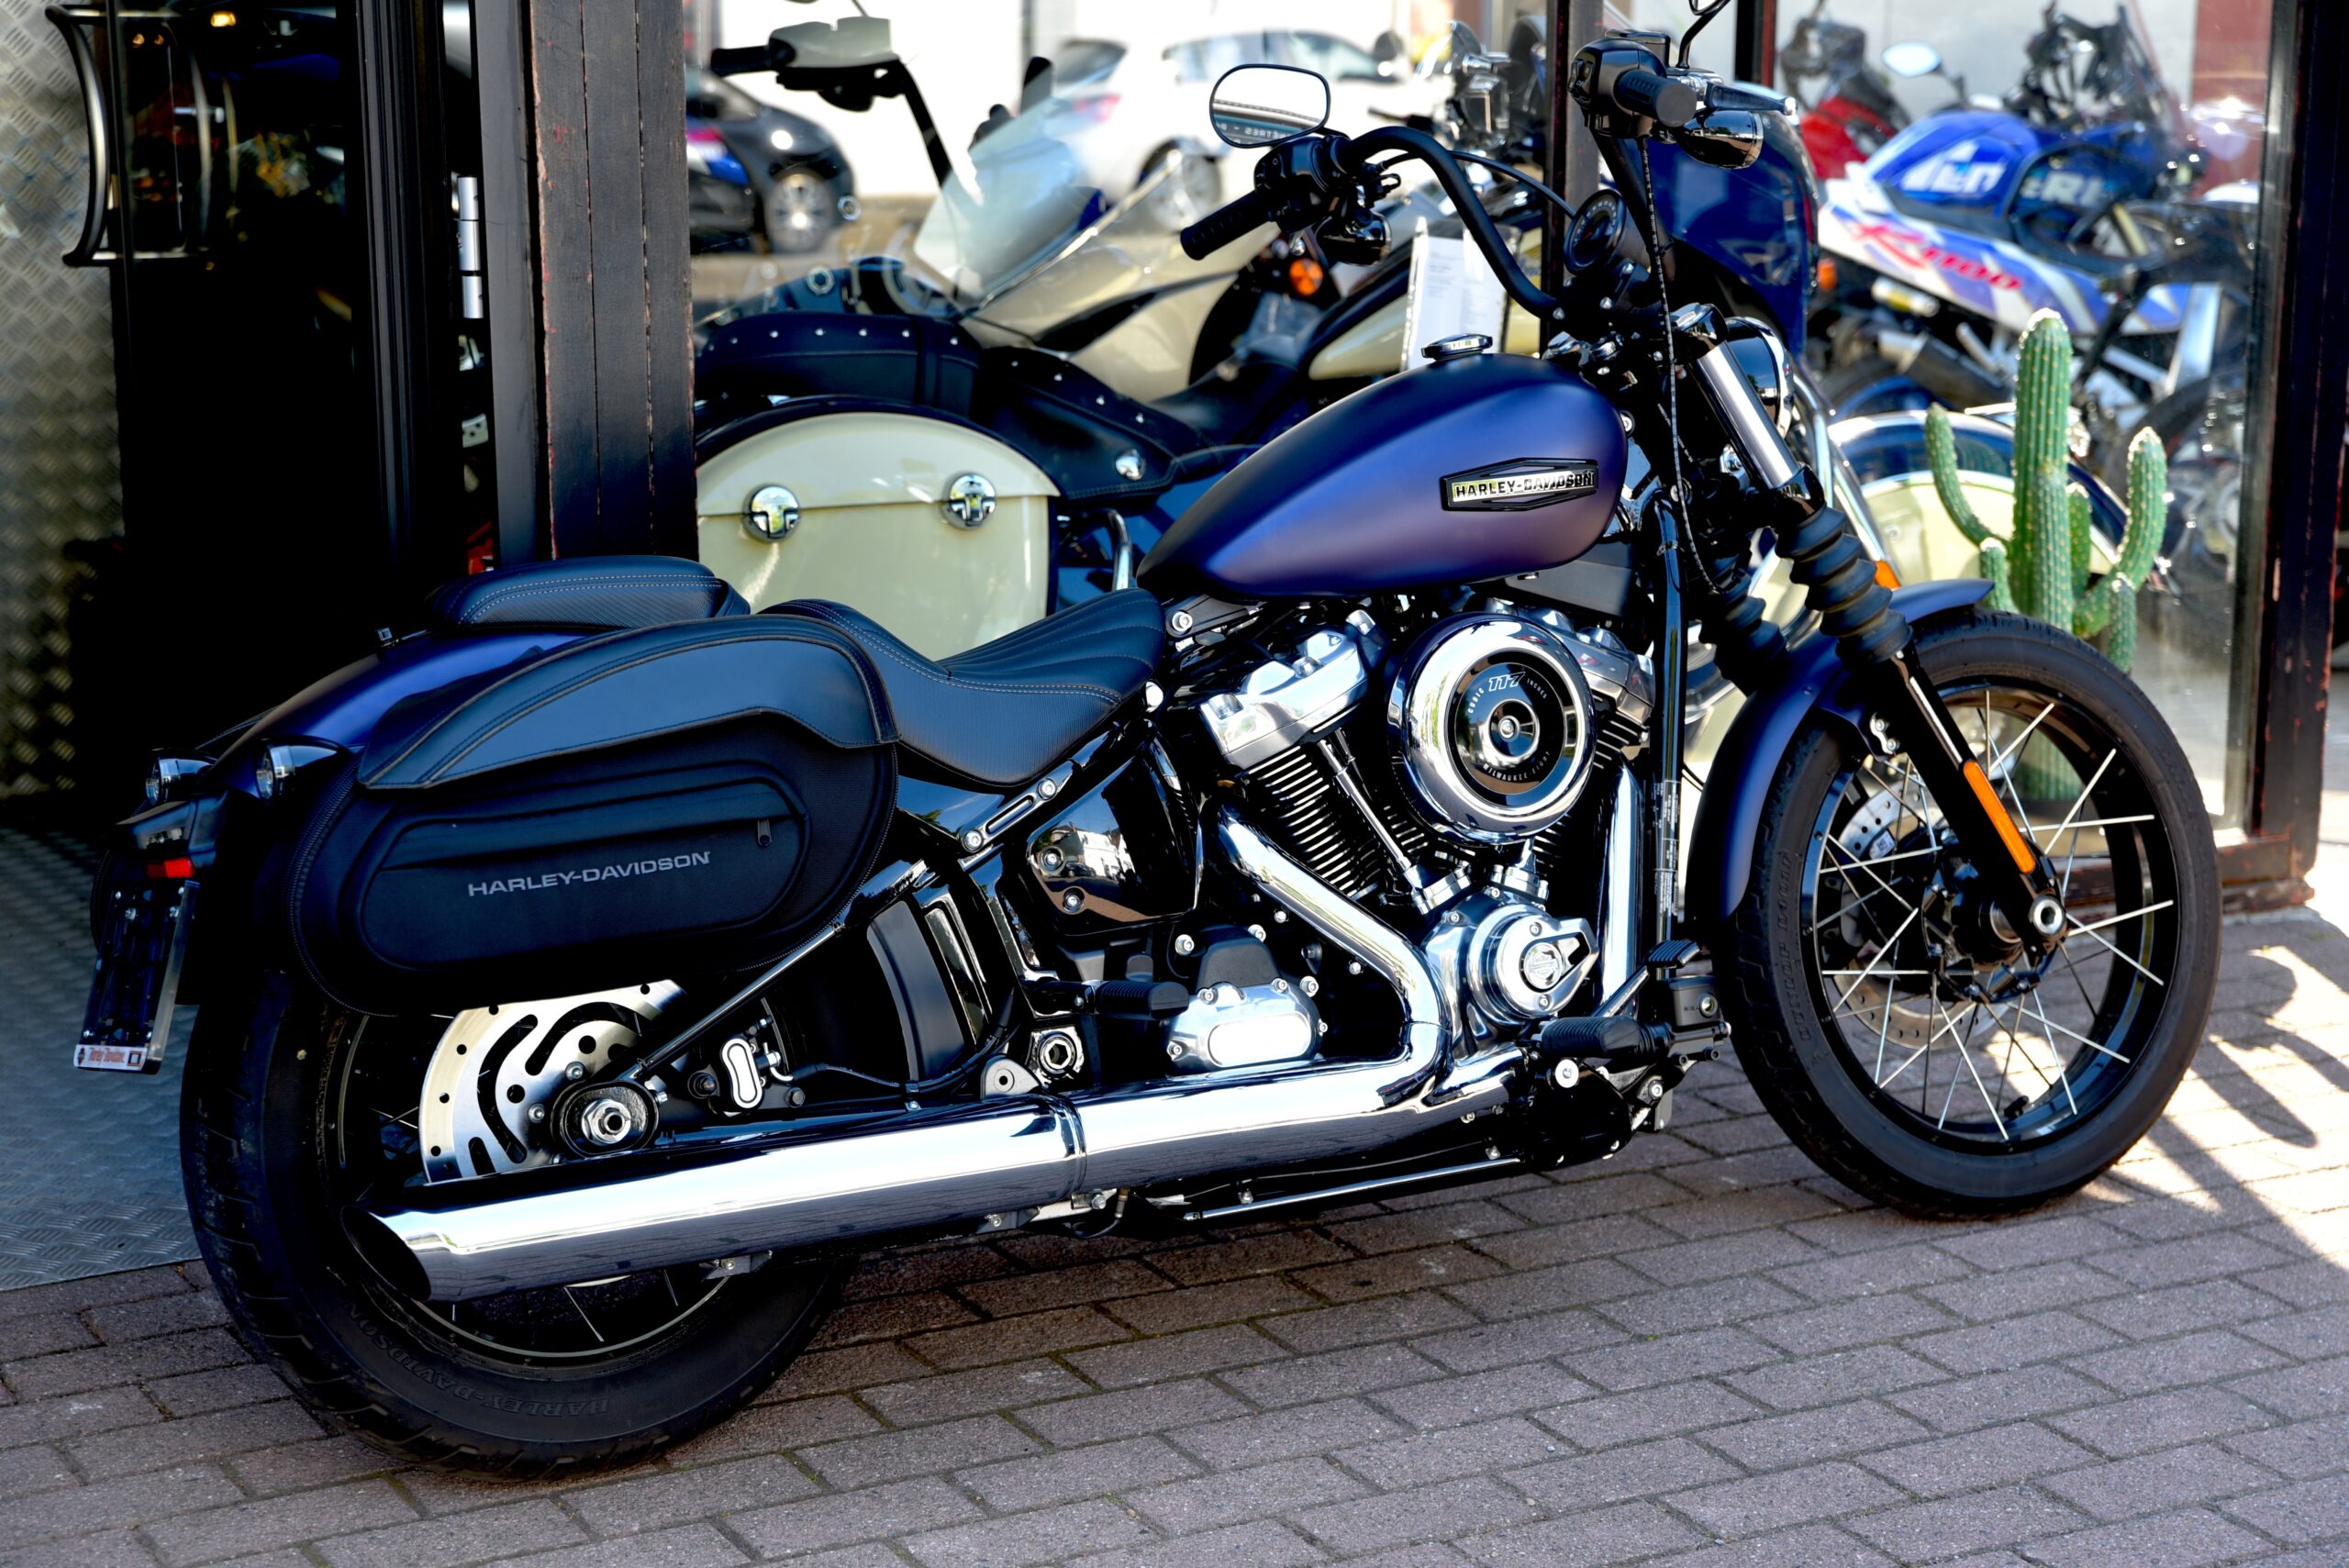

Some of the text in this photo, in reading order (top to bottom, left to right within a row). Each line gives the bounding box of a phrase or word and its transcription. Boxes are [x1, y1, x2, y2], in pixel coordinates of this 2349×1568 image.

[1455, 470, 1595, 497] HARLEY-DAVIDSON
[1468, 671, 1548, 714] CUBIC 117 INCHES
[1482, 751, 1552, 782] MILWAUKEE-EIGHT
[467, 851, 711, 897] HARLEY-DAVIDSON
[343, 1299, 609, 1418] HARLEY-DAVIDSON
